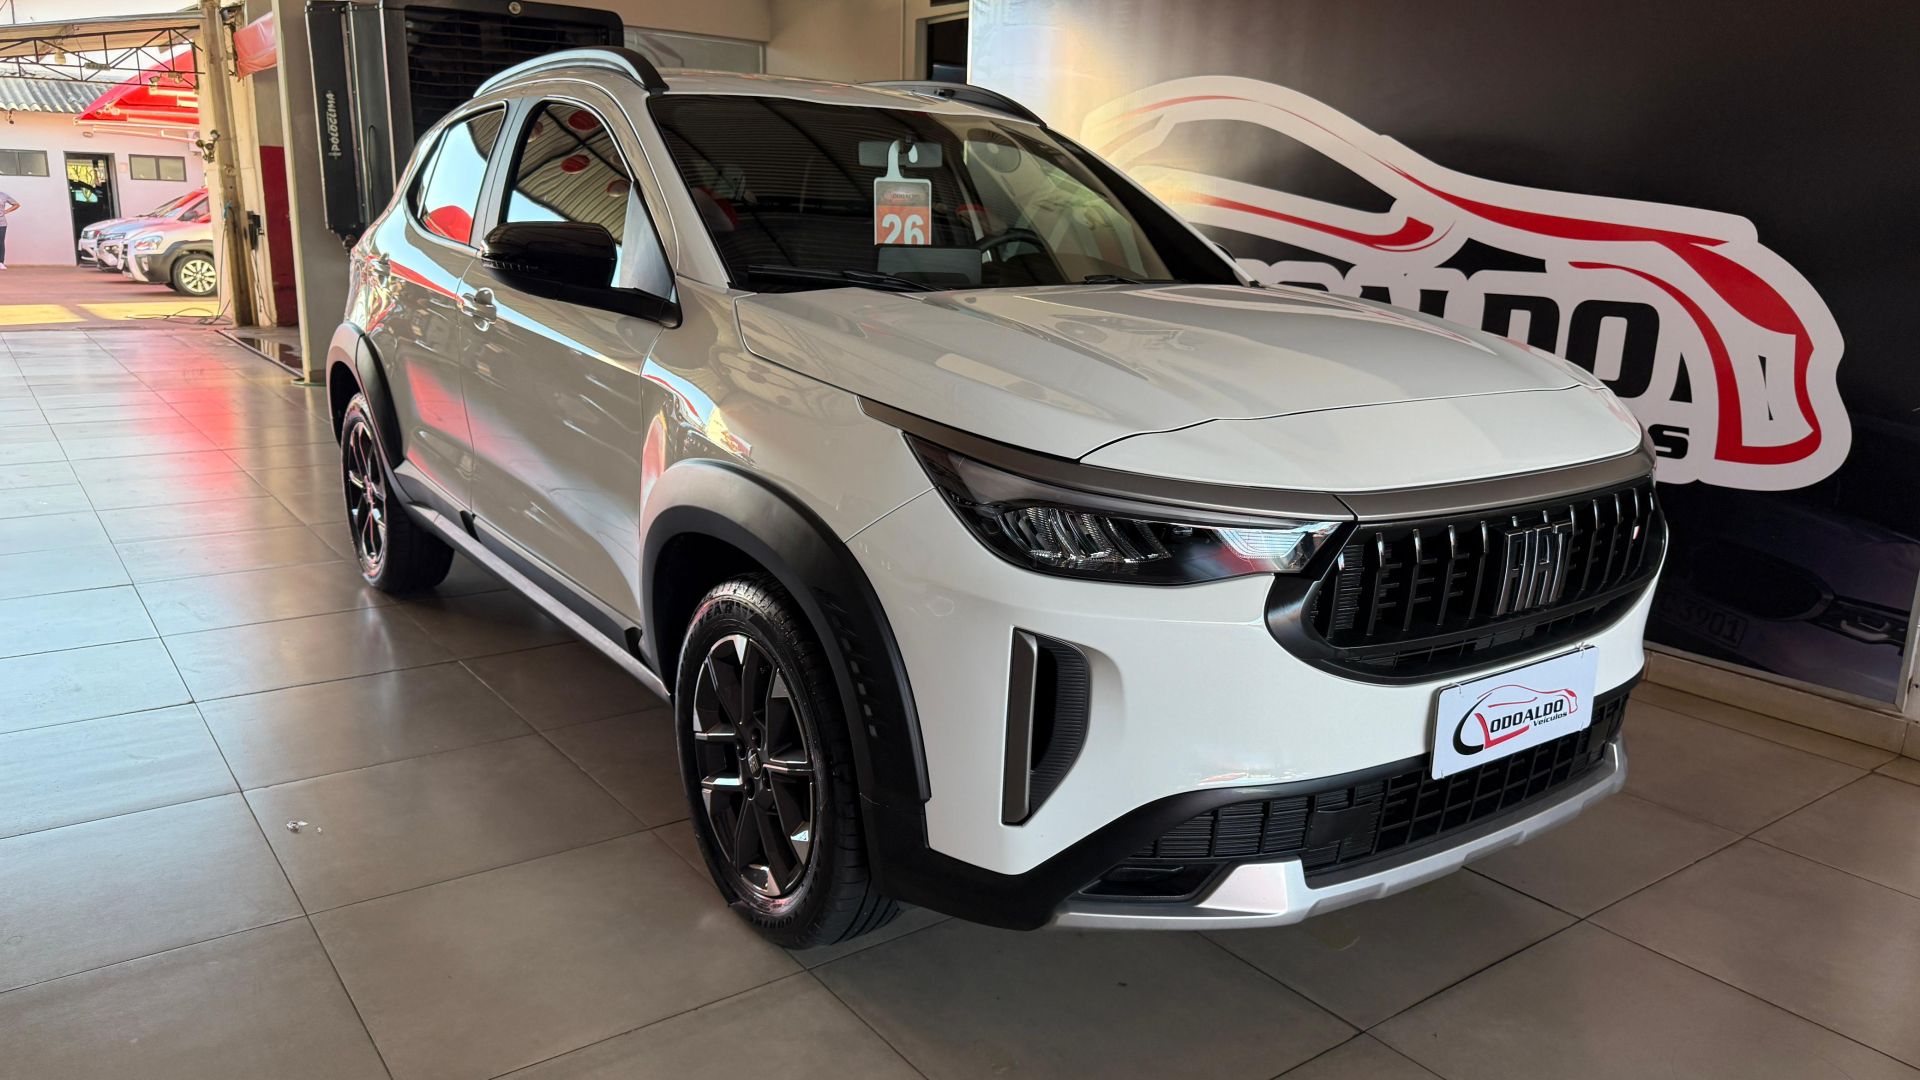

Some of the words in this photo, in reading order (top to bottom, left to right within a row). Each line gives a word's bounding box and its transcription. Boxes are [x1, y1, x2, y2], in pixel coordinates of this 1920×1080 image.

[326, 92, 341, 152] POLOCLIMA
[881, 213, 925, 245] 26
[1497, 521, 1573, 616] FIAT
